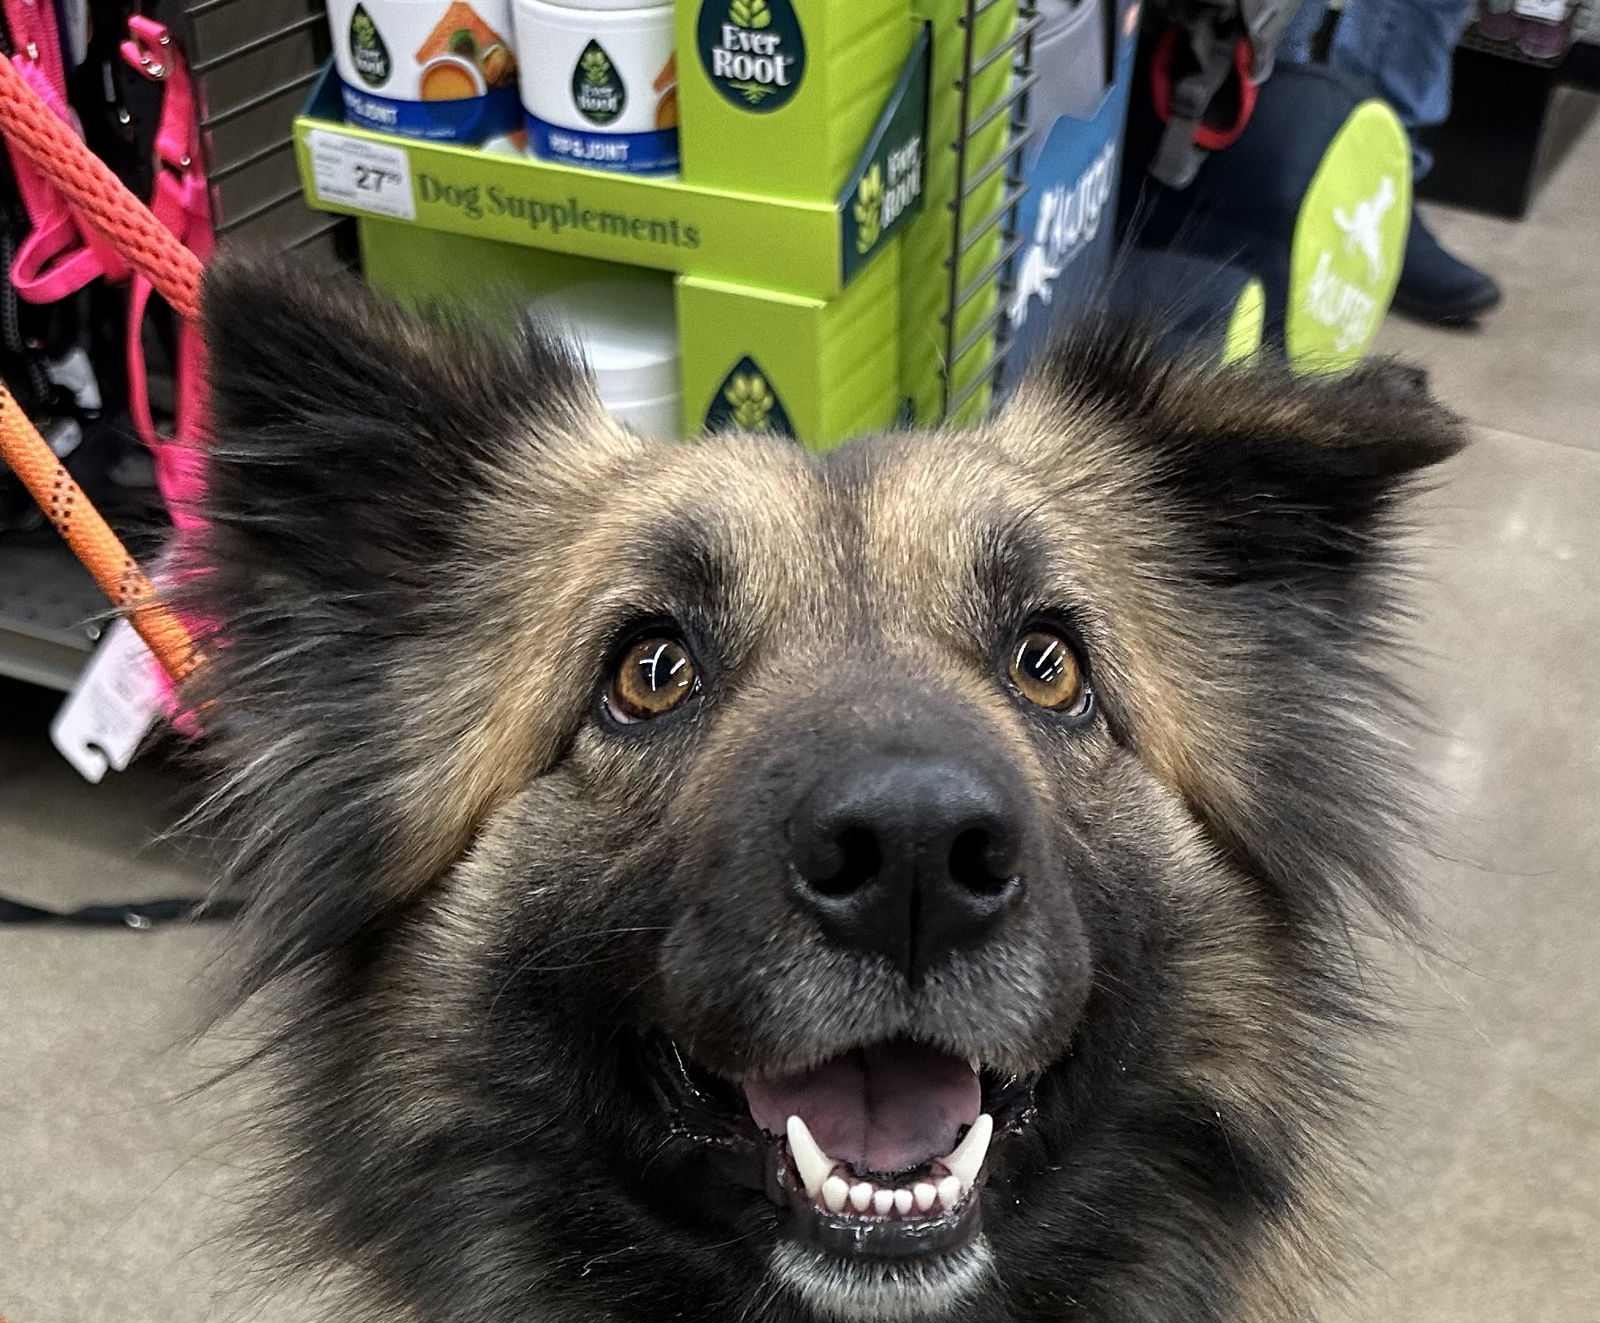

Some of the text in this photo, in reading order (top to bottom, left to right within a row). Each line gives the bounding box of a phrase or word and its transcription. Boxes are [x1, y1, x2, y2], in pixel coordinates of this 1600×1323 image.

[722, 25, 781, 55] Ever
[712, 49, 791, 86] Root
[418, 174, 701, 250] Dog Supplements
